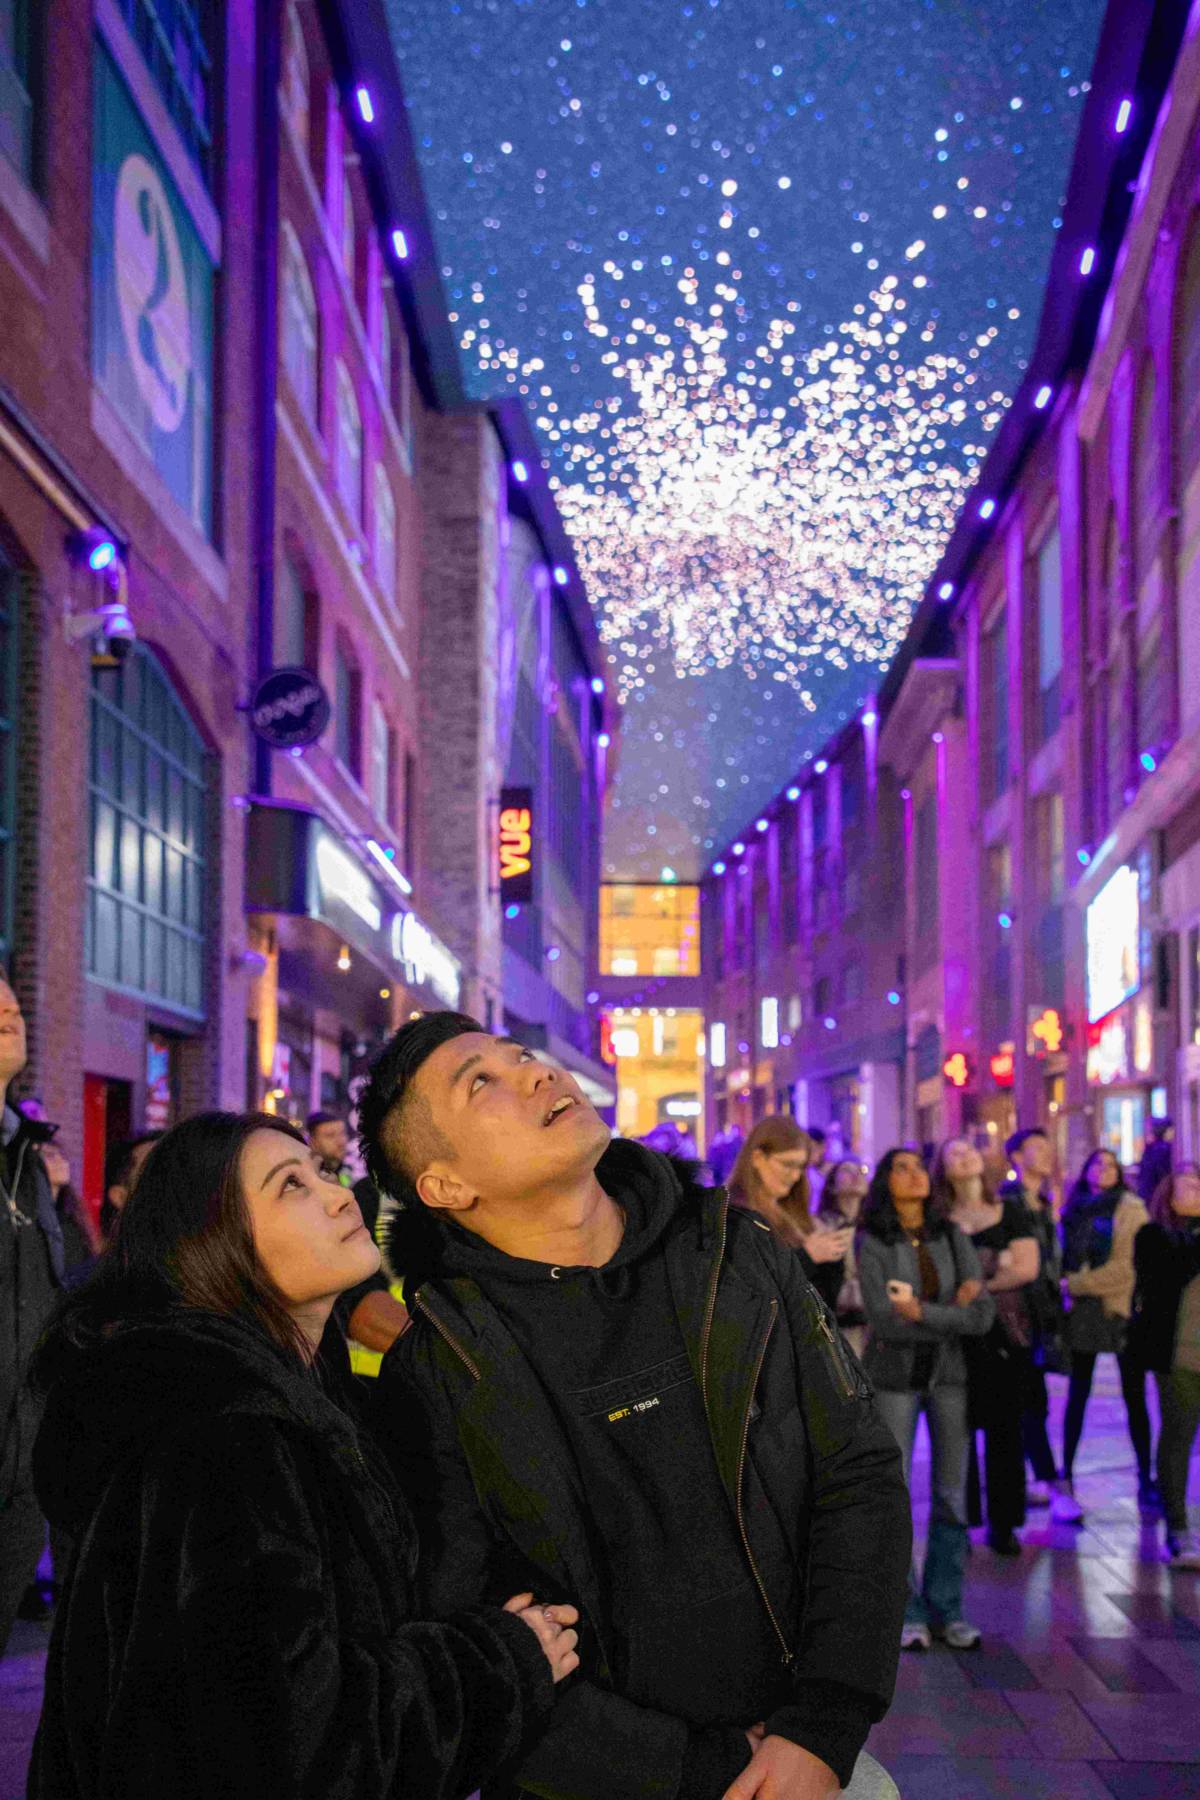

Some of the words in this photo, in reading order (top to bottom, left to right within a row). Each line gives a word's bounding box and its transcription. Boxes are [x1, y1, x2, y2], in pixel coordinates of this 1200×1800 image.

[500, 808, 531, 878] vue
[608, 1408, 631, 1422] EST.
[633, 1398, 660, 1413] 1994
